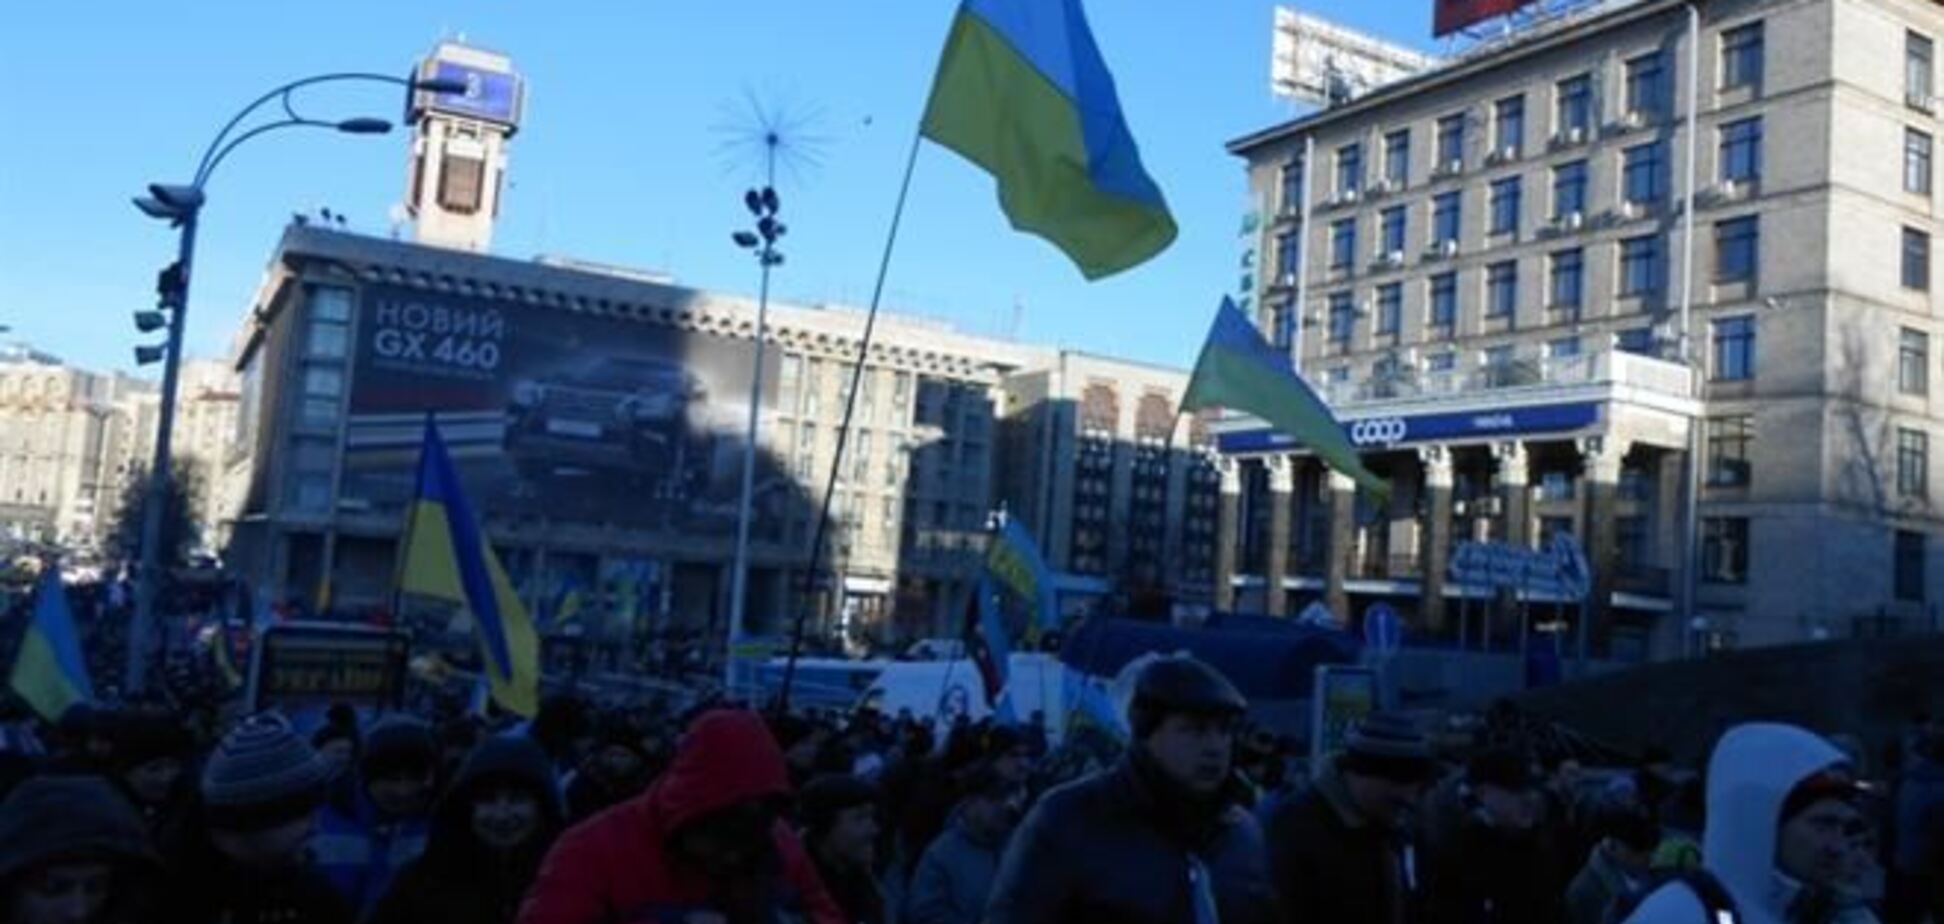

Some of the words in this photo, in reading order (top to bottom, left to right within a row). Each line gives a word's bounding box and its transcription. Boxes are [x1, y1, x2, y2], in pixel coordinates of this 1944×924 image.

[375, 300, 505, 339] НОВИЙ
[373, 328, 426, 358] GX
[433, 336, 500, 370] 460
